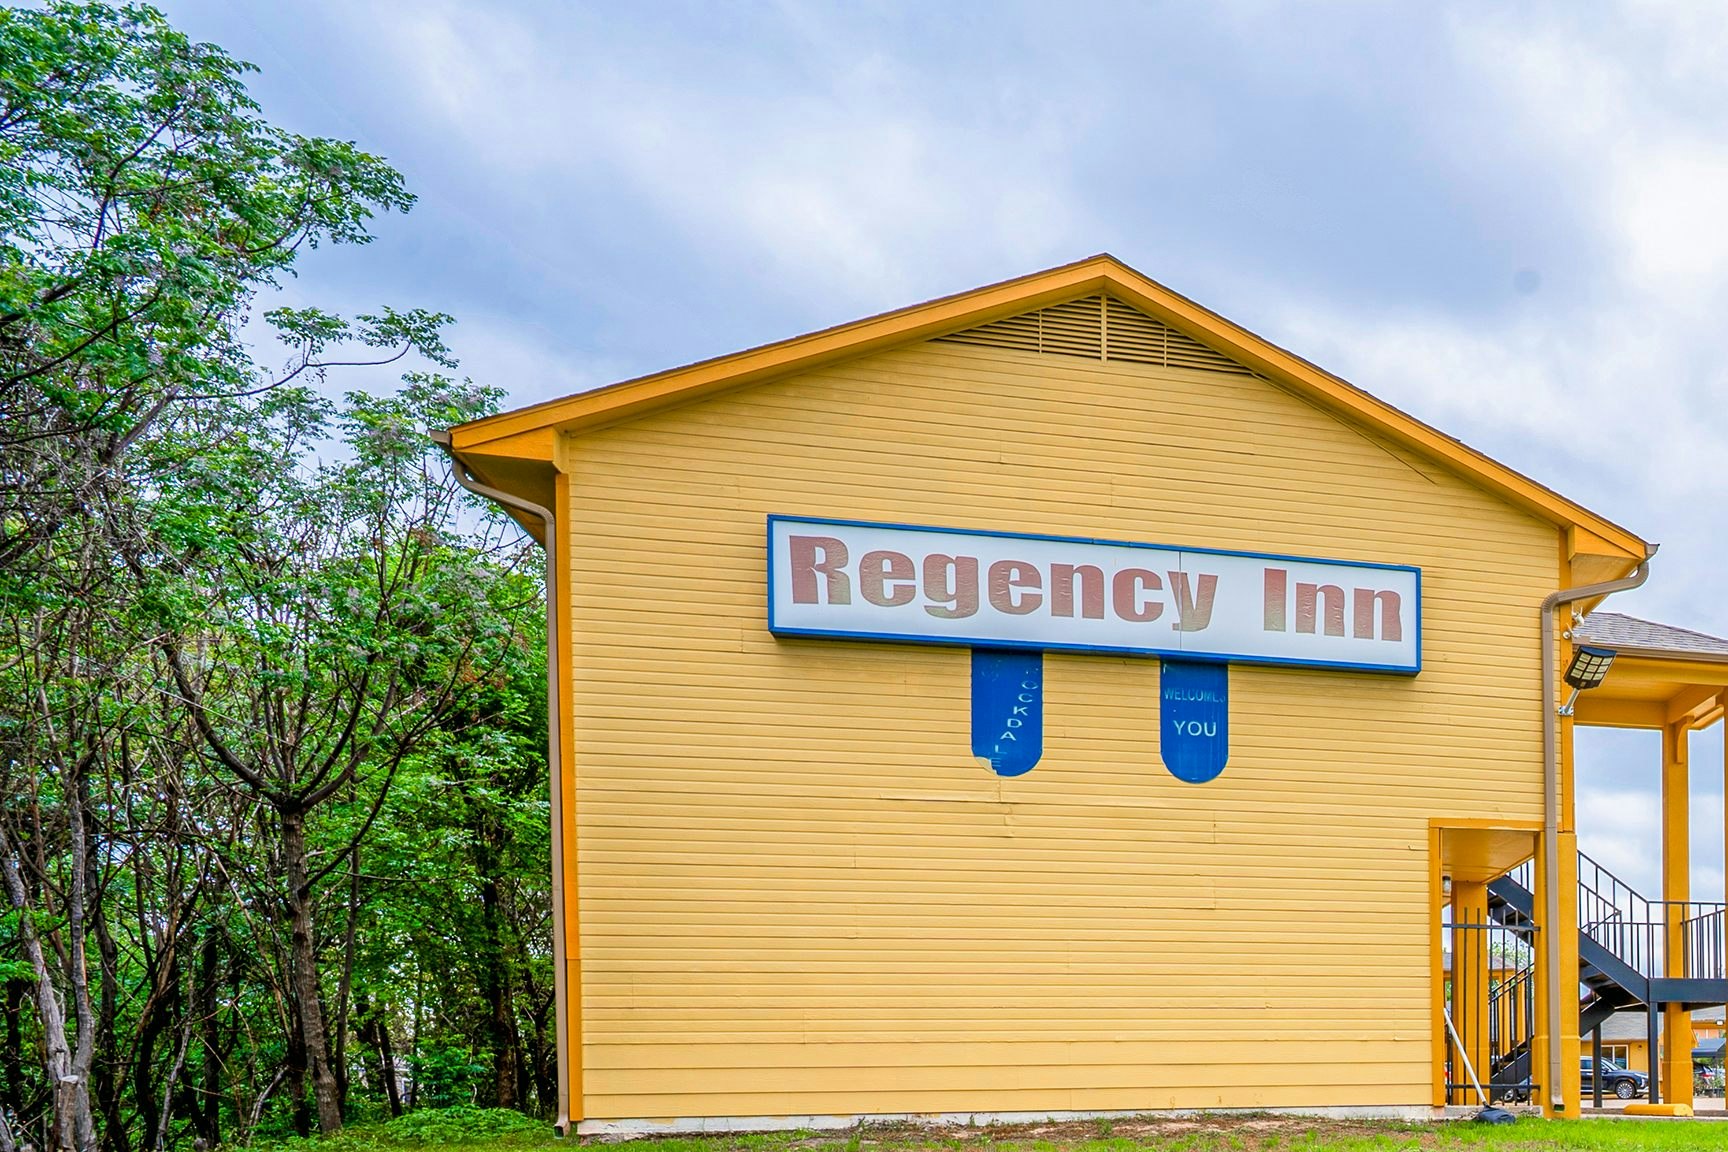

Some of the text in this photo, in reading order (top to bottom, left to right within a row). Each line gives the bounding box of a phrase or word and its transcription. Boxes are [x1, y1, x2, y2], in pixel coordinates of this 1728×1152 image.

[788, 534, 1402, 642] Regency Inn
[1173, 720, 1217, 737] YOU
